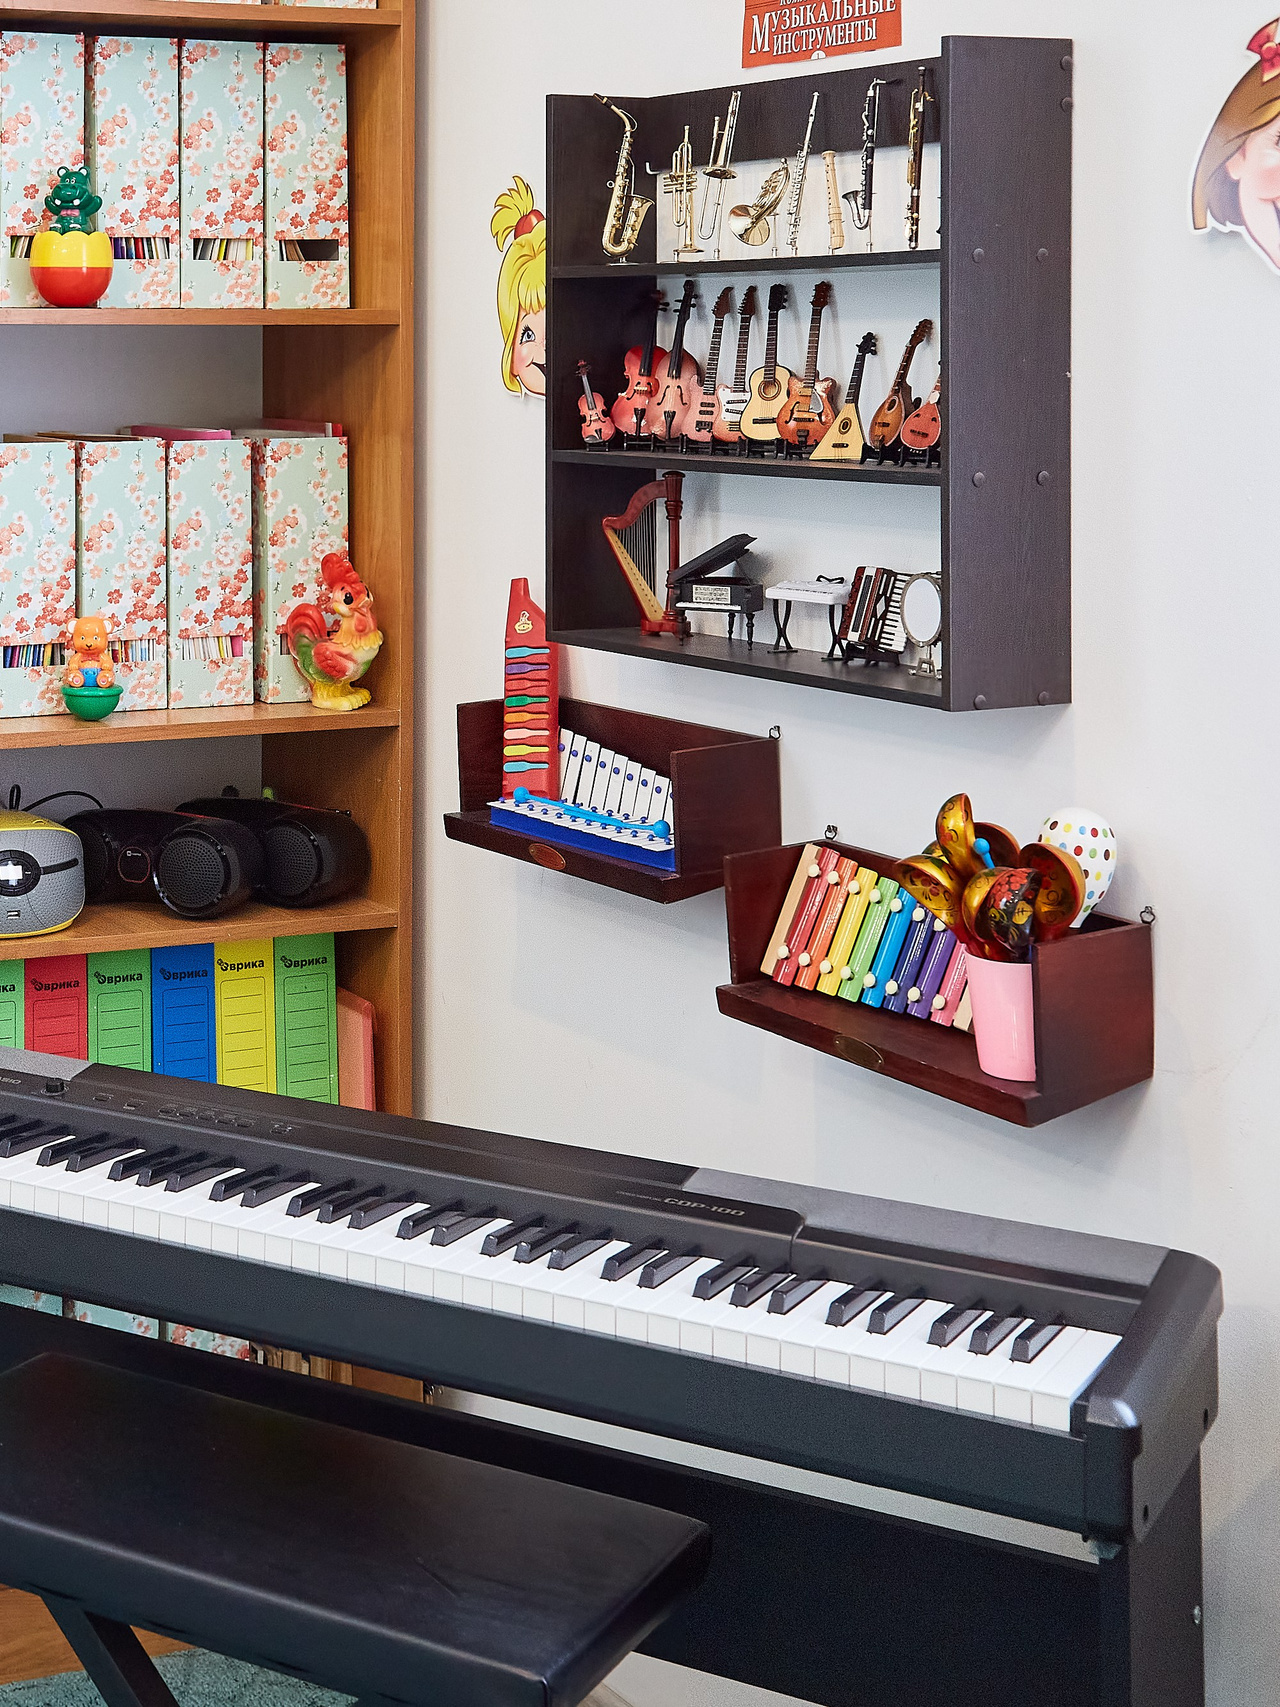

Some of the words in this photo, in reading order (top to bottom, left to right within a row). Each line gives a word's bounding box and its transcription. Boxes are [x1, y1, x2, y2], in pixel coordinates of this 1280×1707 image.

[772, 18, 877, 56] ИНСТРУМЕНТЫ
[216, 958, 265, 972] Эврика
[280, 955, 328, 969] Эврика
[94, 971, 143, 985] Эврика
[159, 967, 208, 981] Эврика
[30, 978, 80, 992] Эврика
[663, 1197, 746, 1216] CDP-100
